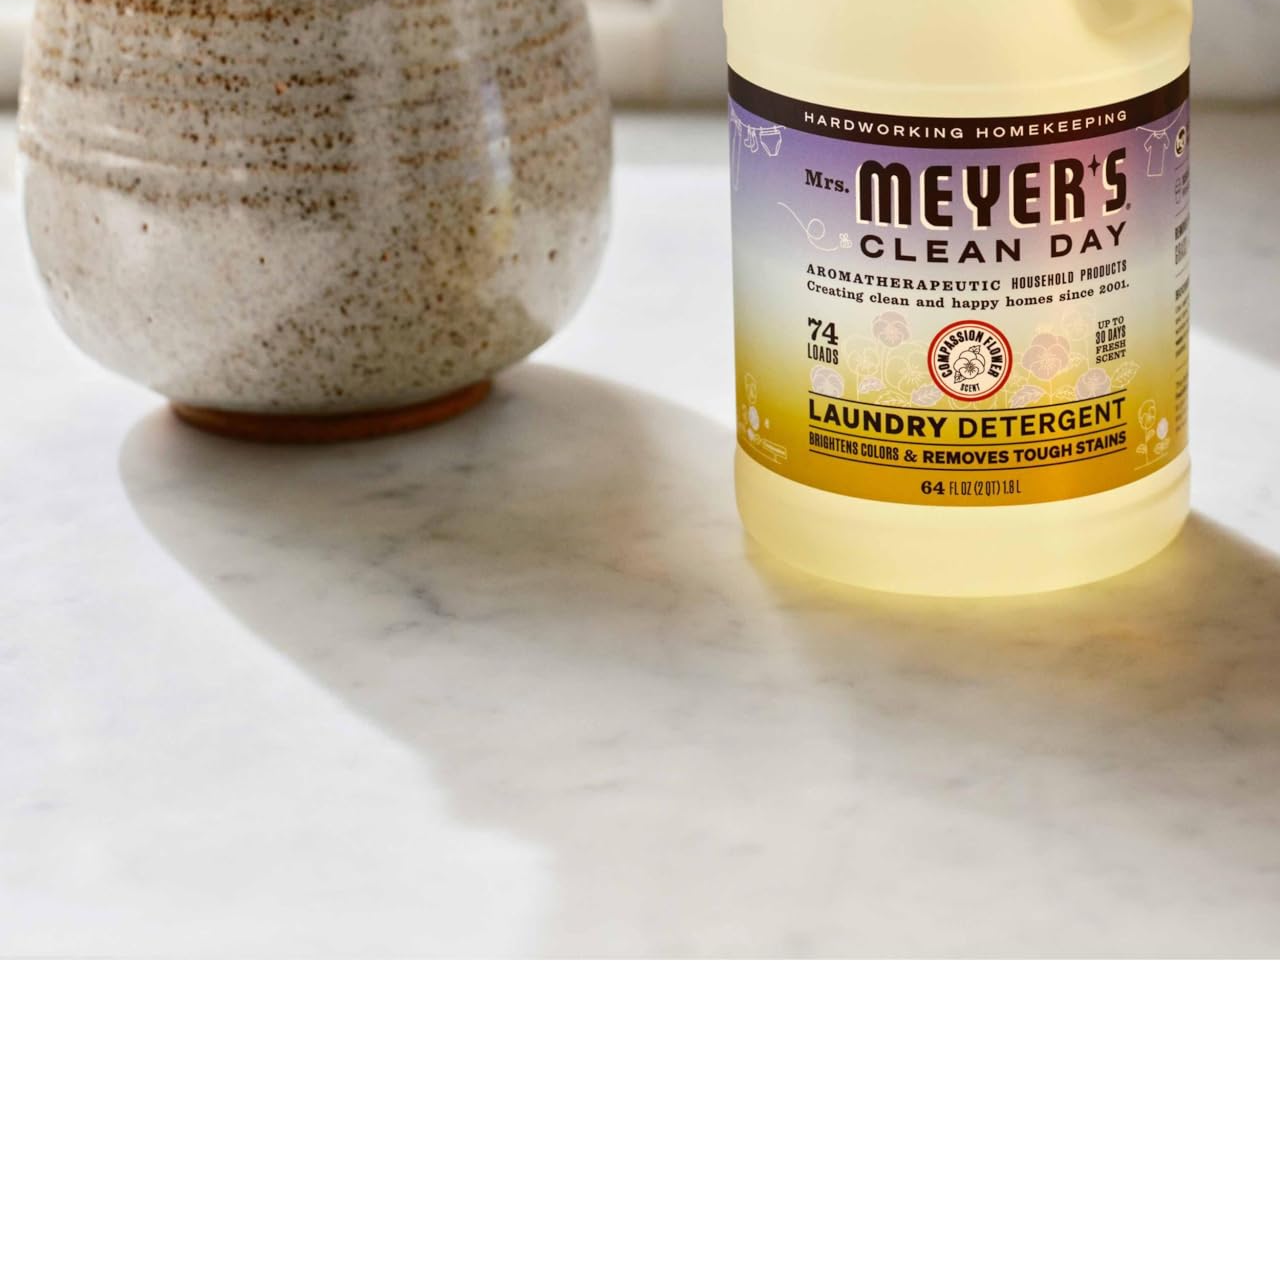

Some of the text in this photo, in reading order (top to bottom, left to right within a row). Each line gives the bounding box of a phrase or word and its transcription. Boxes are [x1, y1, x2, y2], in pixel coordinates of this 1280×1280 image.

[804, 110, 1127, 139] HARDWORKING HOMEKEEPING
[804, 168, 850, 194] Mrs.
[860, 221, 1127, 264] CLEAN DAY
[806, 259, 1127, 292] AROMATHERAPEUTIC HOUSEHOLD PRODUCTS
[807, 279, 1130, 311] Creating clean and happy homes since 2001.
[807, 316, 839, 346] 74
[1095, 324, 1126, 345] 30 DAYS
[1097, 315, 1125, 330] UP TO
[807, 342, 839, 366] LOADS
[937, 329, 1003, 379] COMPASSION FLOWER
[1095, 339, 1126, 355] FRESH
[1095, 349, 1127, 364] SCENT
[960, 383, 981, 393] SCENT
[809, 398, 948, 439] LAUNDRY
[958, 396, 1126, 439] DETERGENT
[809, 431, 1127, 465] BRIGHTENS COLORS & REMOVES TOUGH STAINS
[920, 480, 945, 495] 64
[949, 480, 959, 496] FL
[961, 480, 972, 496] OZ
[1003, 479, 1015, 495] 1.8
[1016, 479, 1022, 494] L
